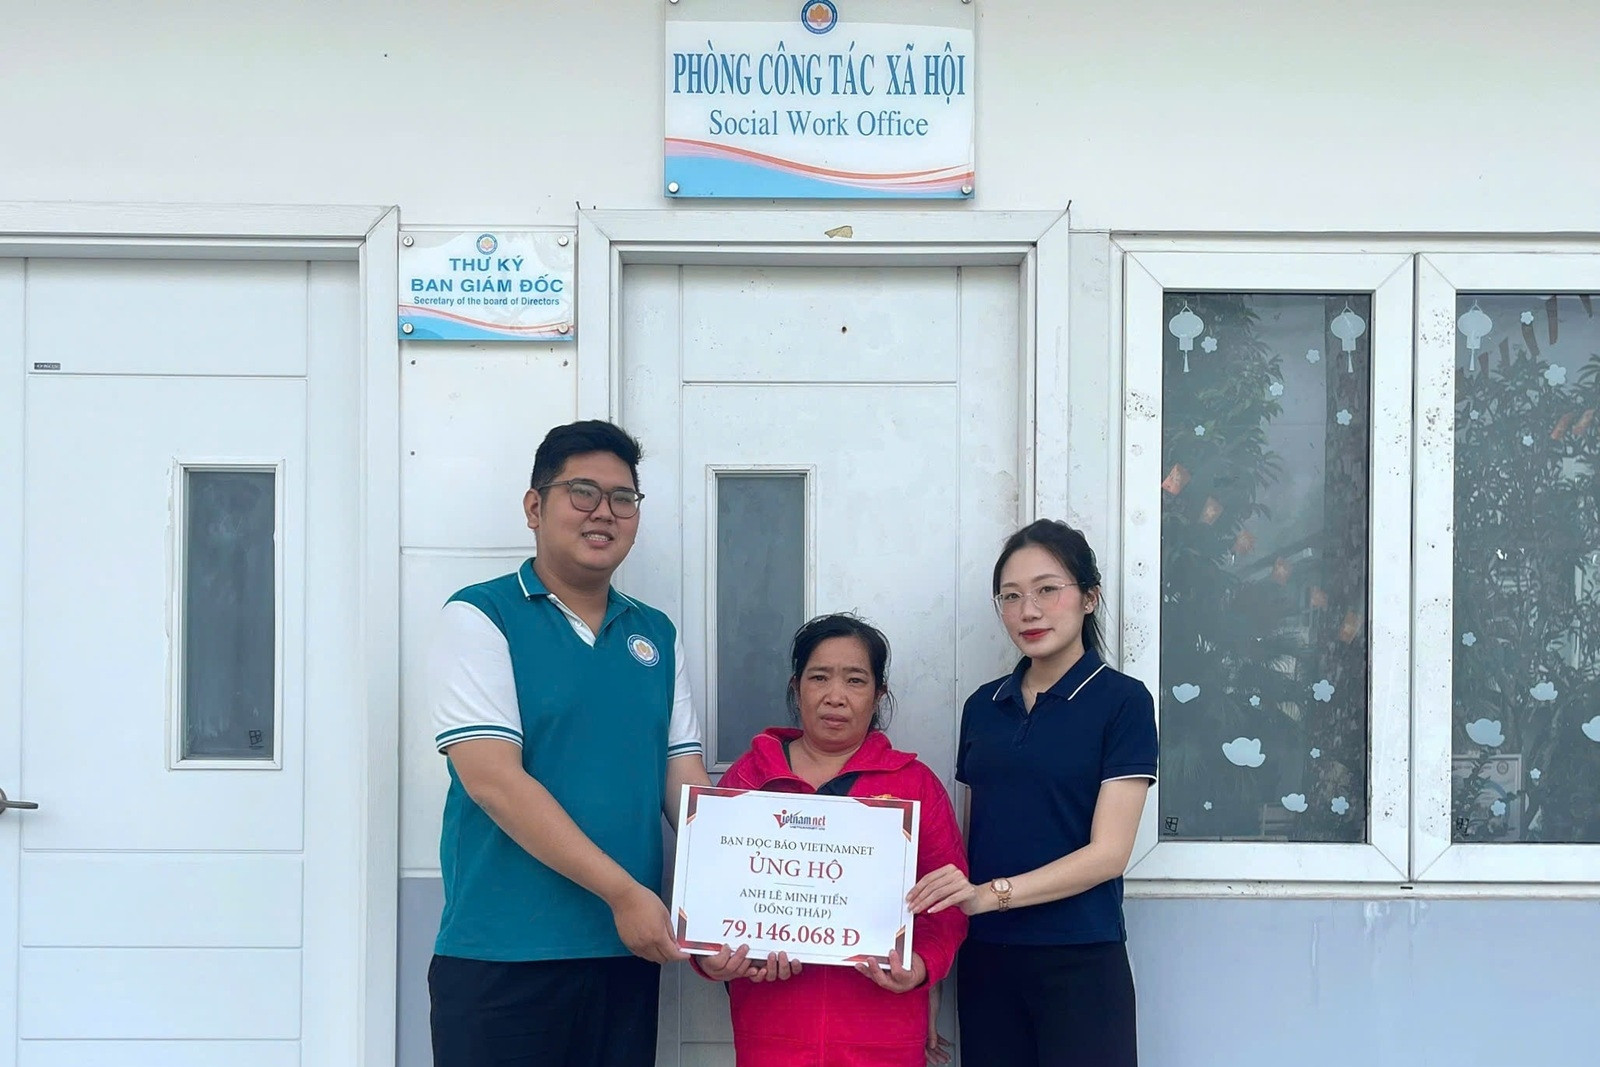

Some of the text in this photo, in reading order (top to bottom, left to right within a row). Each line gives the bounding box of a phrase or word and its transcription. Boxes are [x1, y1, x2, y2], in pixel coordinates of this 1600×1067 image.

[673, 40, 966, 105] PHÒNG CÔNG TÁC XÃ HỘI
[709, 110, 929, 136] Social Work Office
[449, 255, 524, 272] THƯ KÝ
[411, 274, 564, 293] BAN GIÁM ĐỐC
[413, 296, 560, 307] Secretary of the board of Directors
[720, 835, 875, 856] BẠN ĐỌC BÁO VIETNAMNET
[749, 851, 844, 883] ỦNG HỘ
[739, 888, 767, 899] ANH
[768, 889, 783, 901] LÊ
[784, 891, 818, 904] MINH
[795, 906, 832, 919] THÁP)
[722, 919, 861, 947] 79.146.068 Đ
